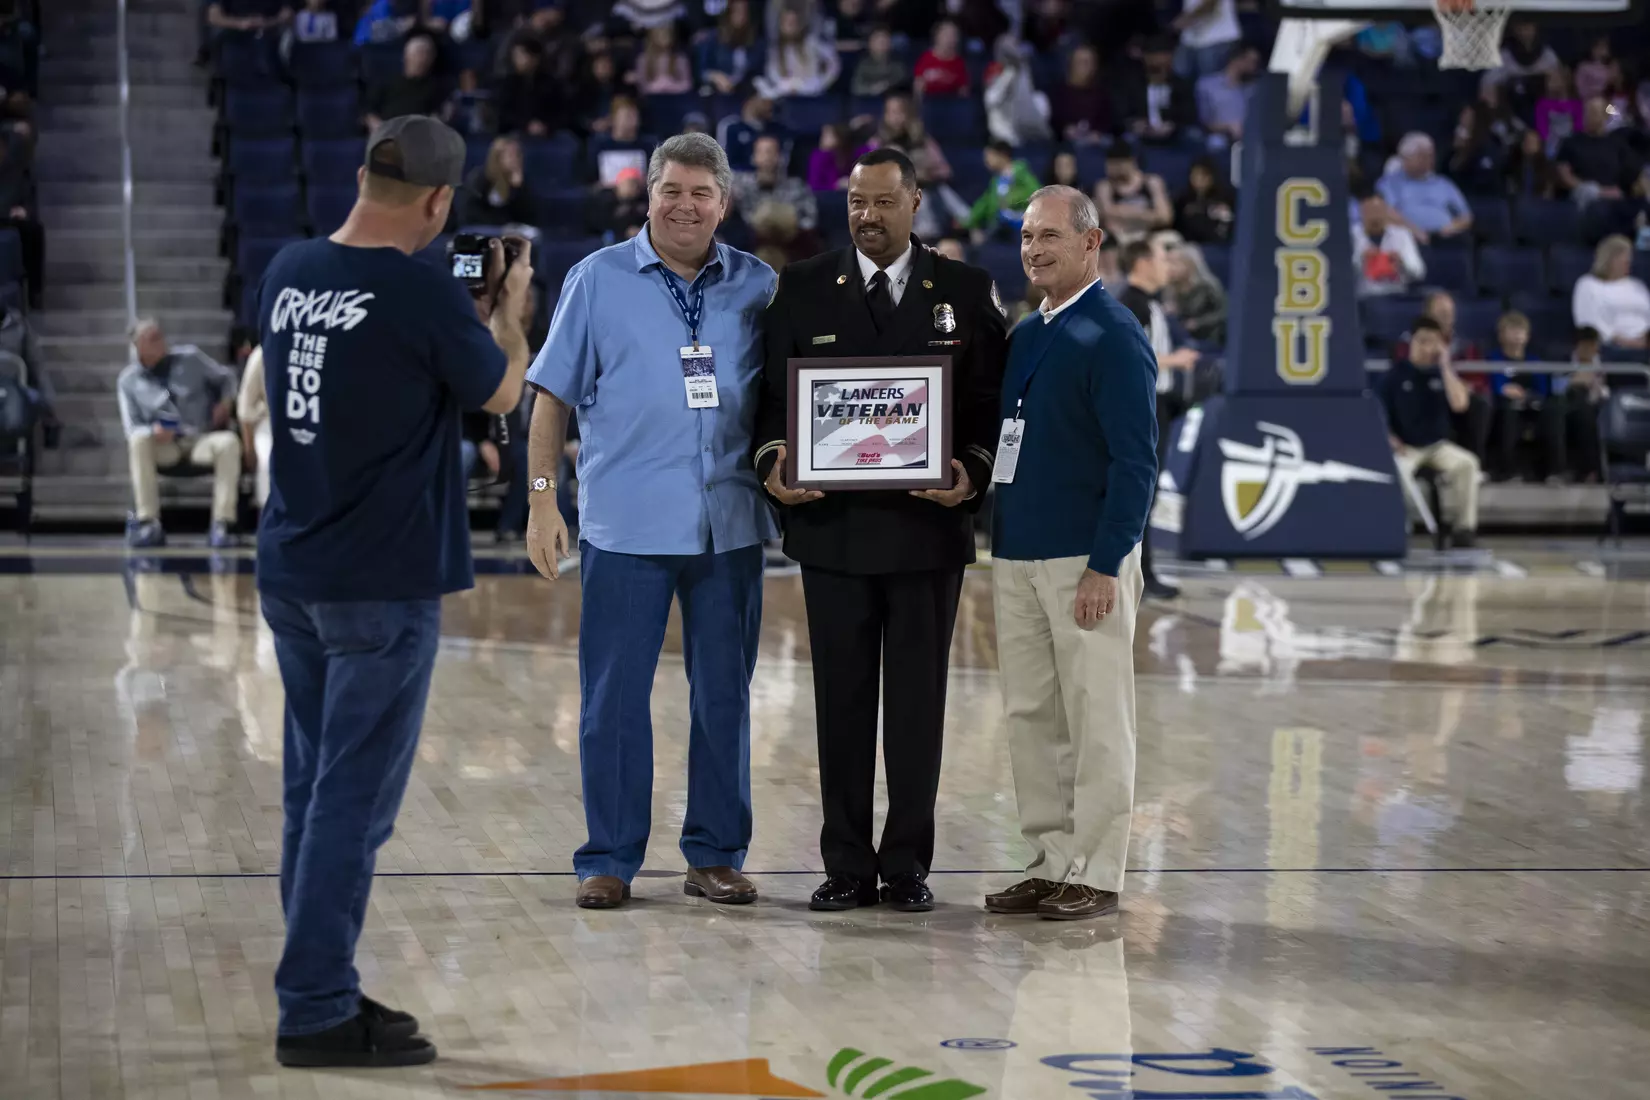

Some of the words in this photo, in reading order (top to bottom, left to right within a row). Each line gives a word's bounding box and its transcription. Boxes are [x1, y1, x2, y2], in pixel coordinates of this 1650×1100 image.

[1272, 177, 1332, 385] CBU
[271, 287, 375, 333] CRAZIES
[292, 332, 328, 353] THE
[288, 350, 324, 369] RISE
[287, 366, 321, 394] TO
[842, 388, 904, 400] LANCERS
[286, 390, 320, 423] D1
[817, 403, 922, 417] VETERAN
[859, 417, 880, 425] THE
[885, 417, 919, 425] GAME
